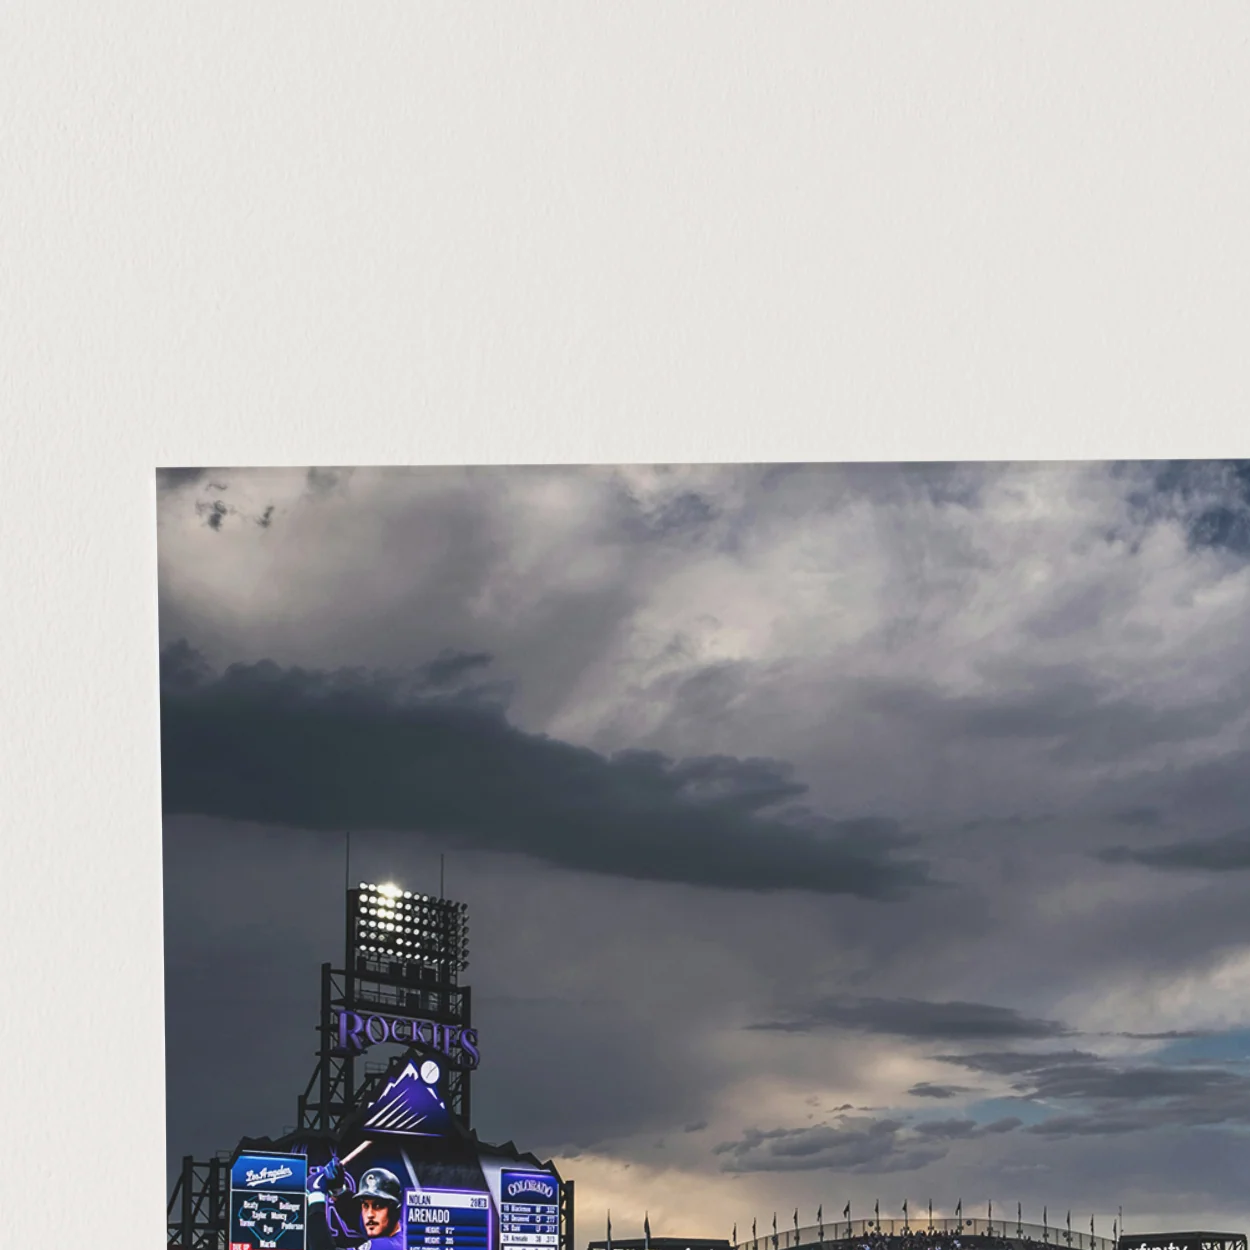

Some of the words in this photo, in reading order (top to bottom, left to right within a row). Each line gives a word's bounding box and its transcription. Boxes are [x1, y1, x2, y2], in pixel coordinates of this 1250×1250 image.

[337, 1007, 480, 1070] ROCKIES
[508, 1179, 554, 1198] COLORADO
[408, 1194, 431, 1205] NOLAN
[408, 1208, 450, 1223] ARENADO
